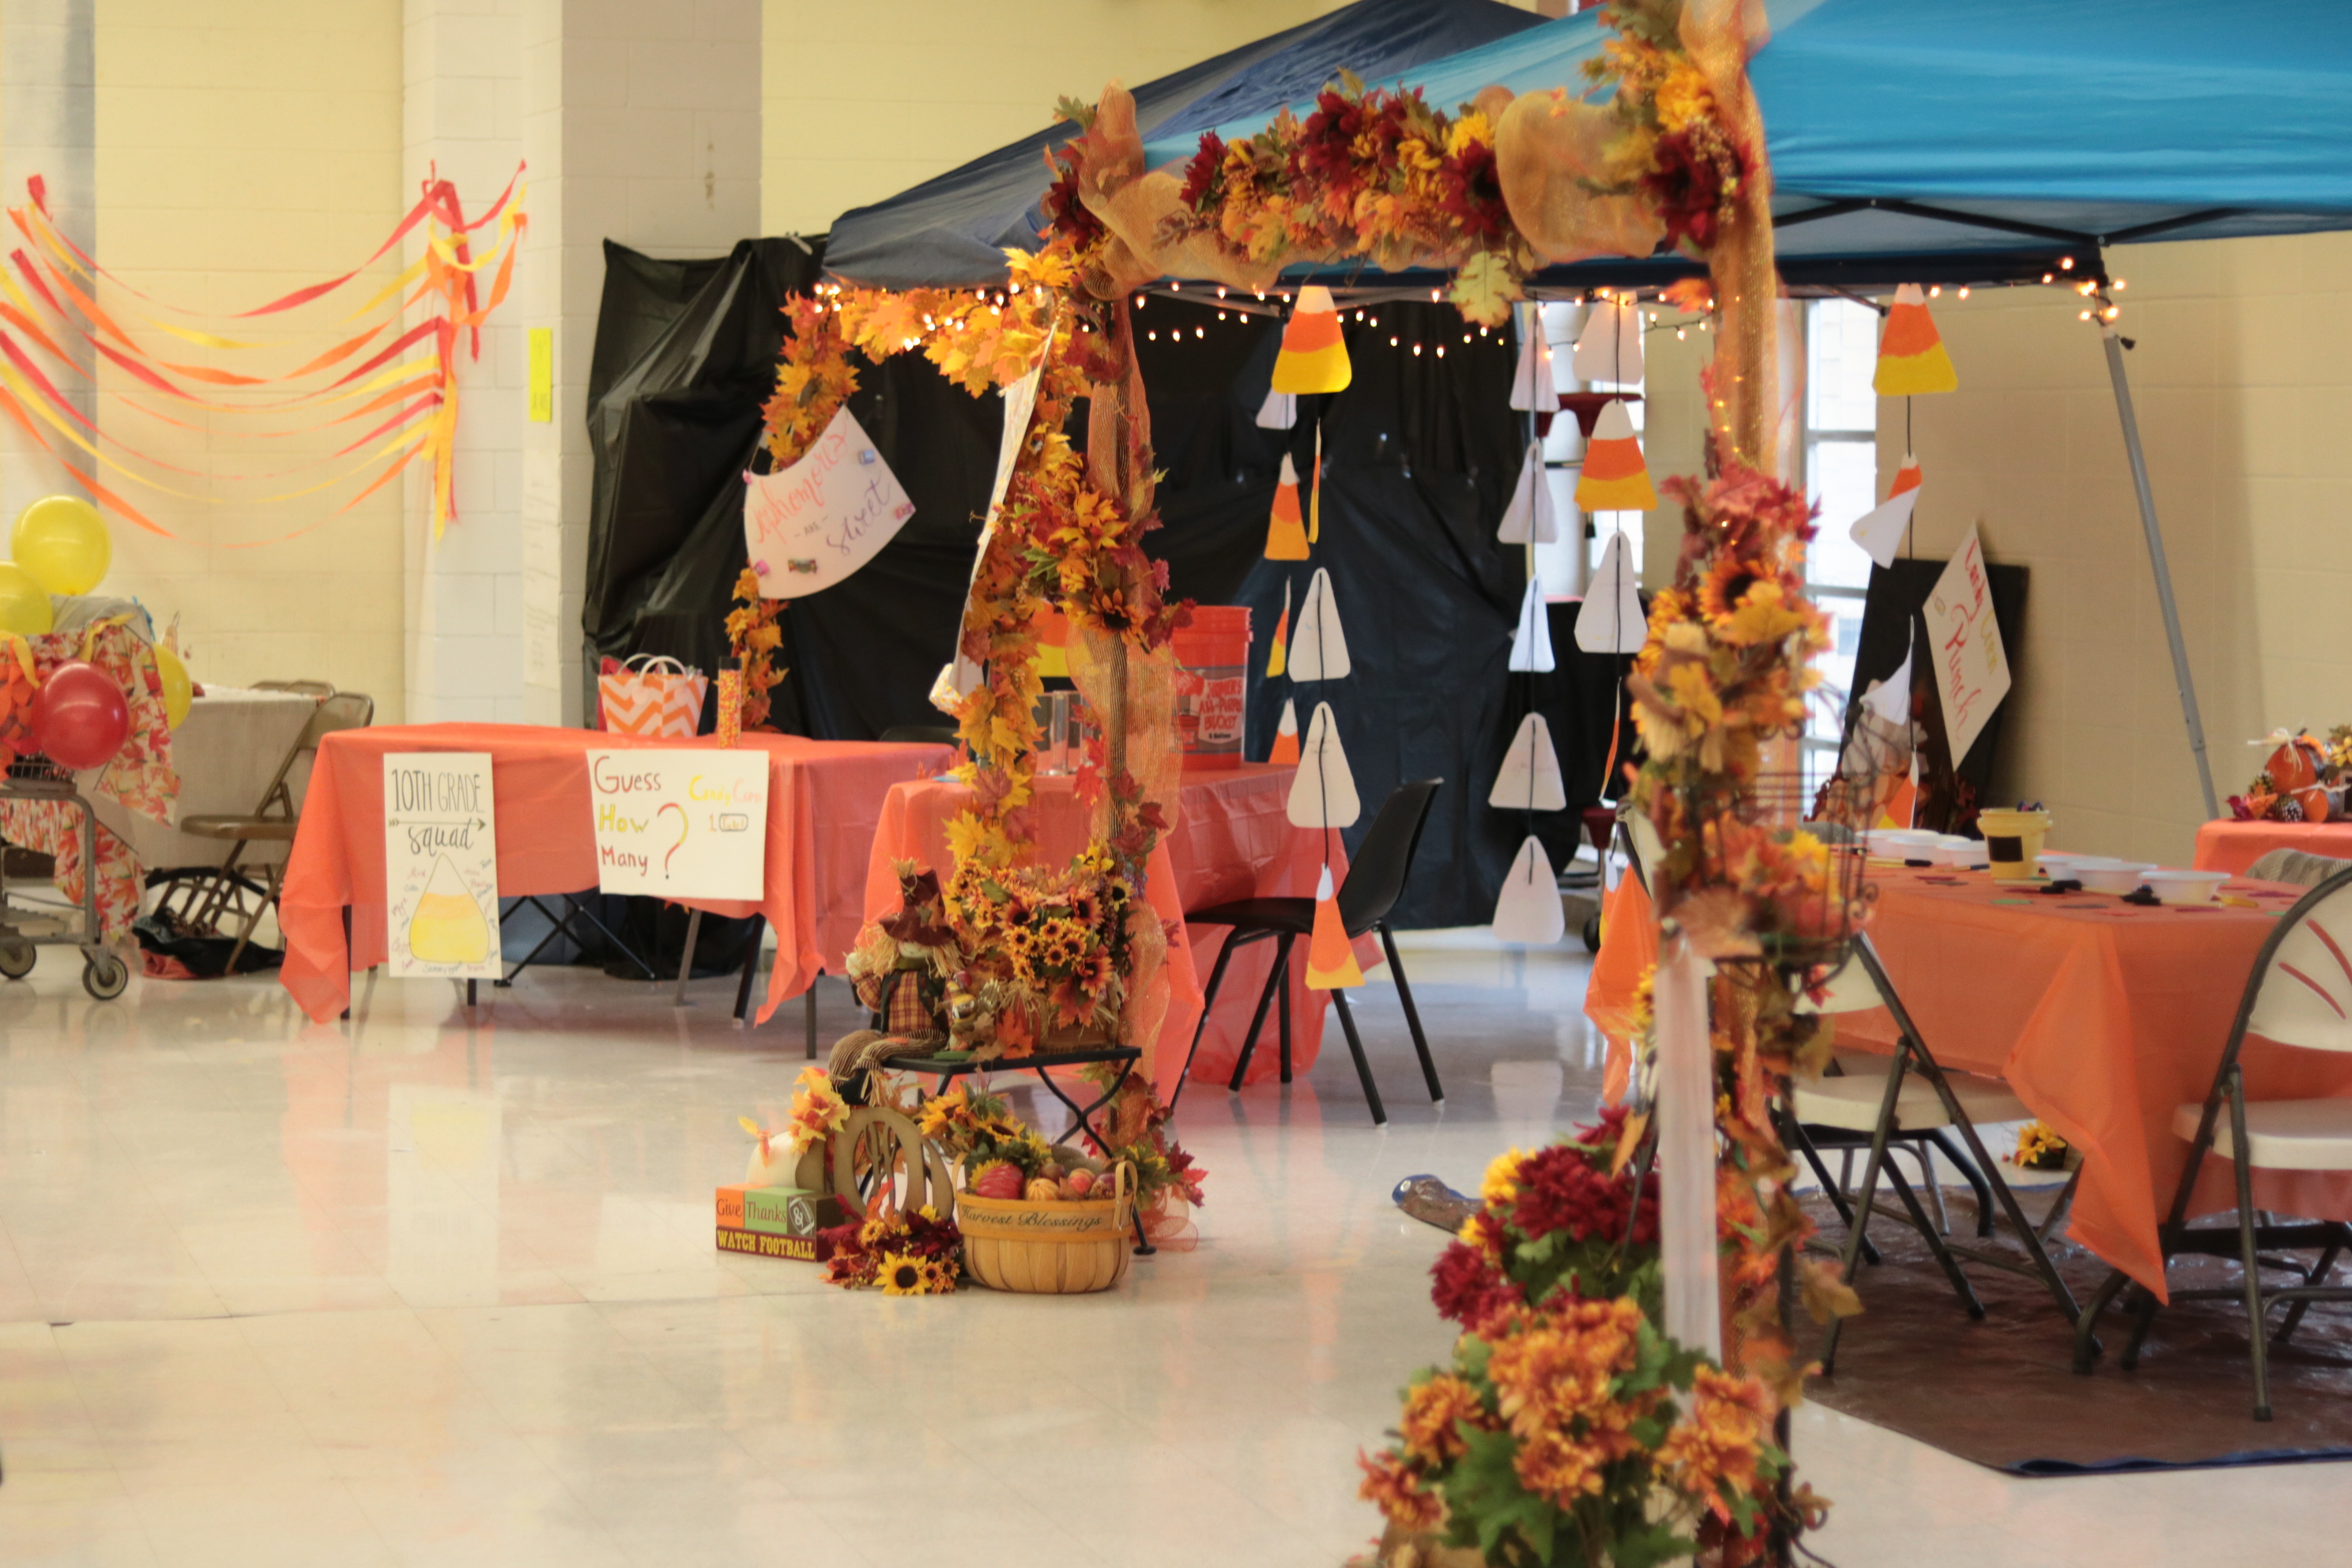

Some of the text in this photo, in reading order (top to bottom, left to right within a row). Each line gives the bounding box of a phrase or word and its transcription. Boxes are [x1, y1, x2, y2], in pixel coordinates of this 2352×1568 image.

[390, 768, 486, 813] 10TH GRADE
[594, 755, 662, 794] Guess
[688, 774, 732, 807] Candy
[598, 803, 650, 834] How
[601, 844, 648, 877] Many
[716, 1197, 743, 1218] Give
[746, 1201, 787, 1224] Thanks
[962, 1204, 1103, 1232] Harvest Blessings
[717, 1229, 816, 1260] WATCH FOOTBALL
